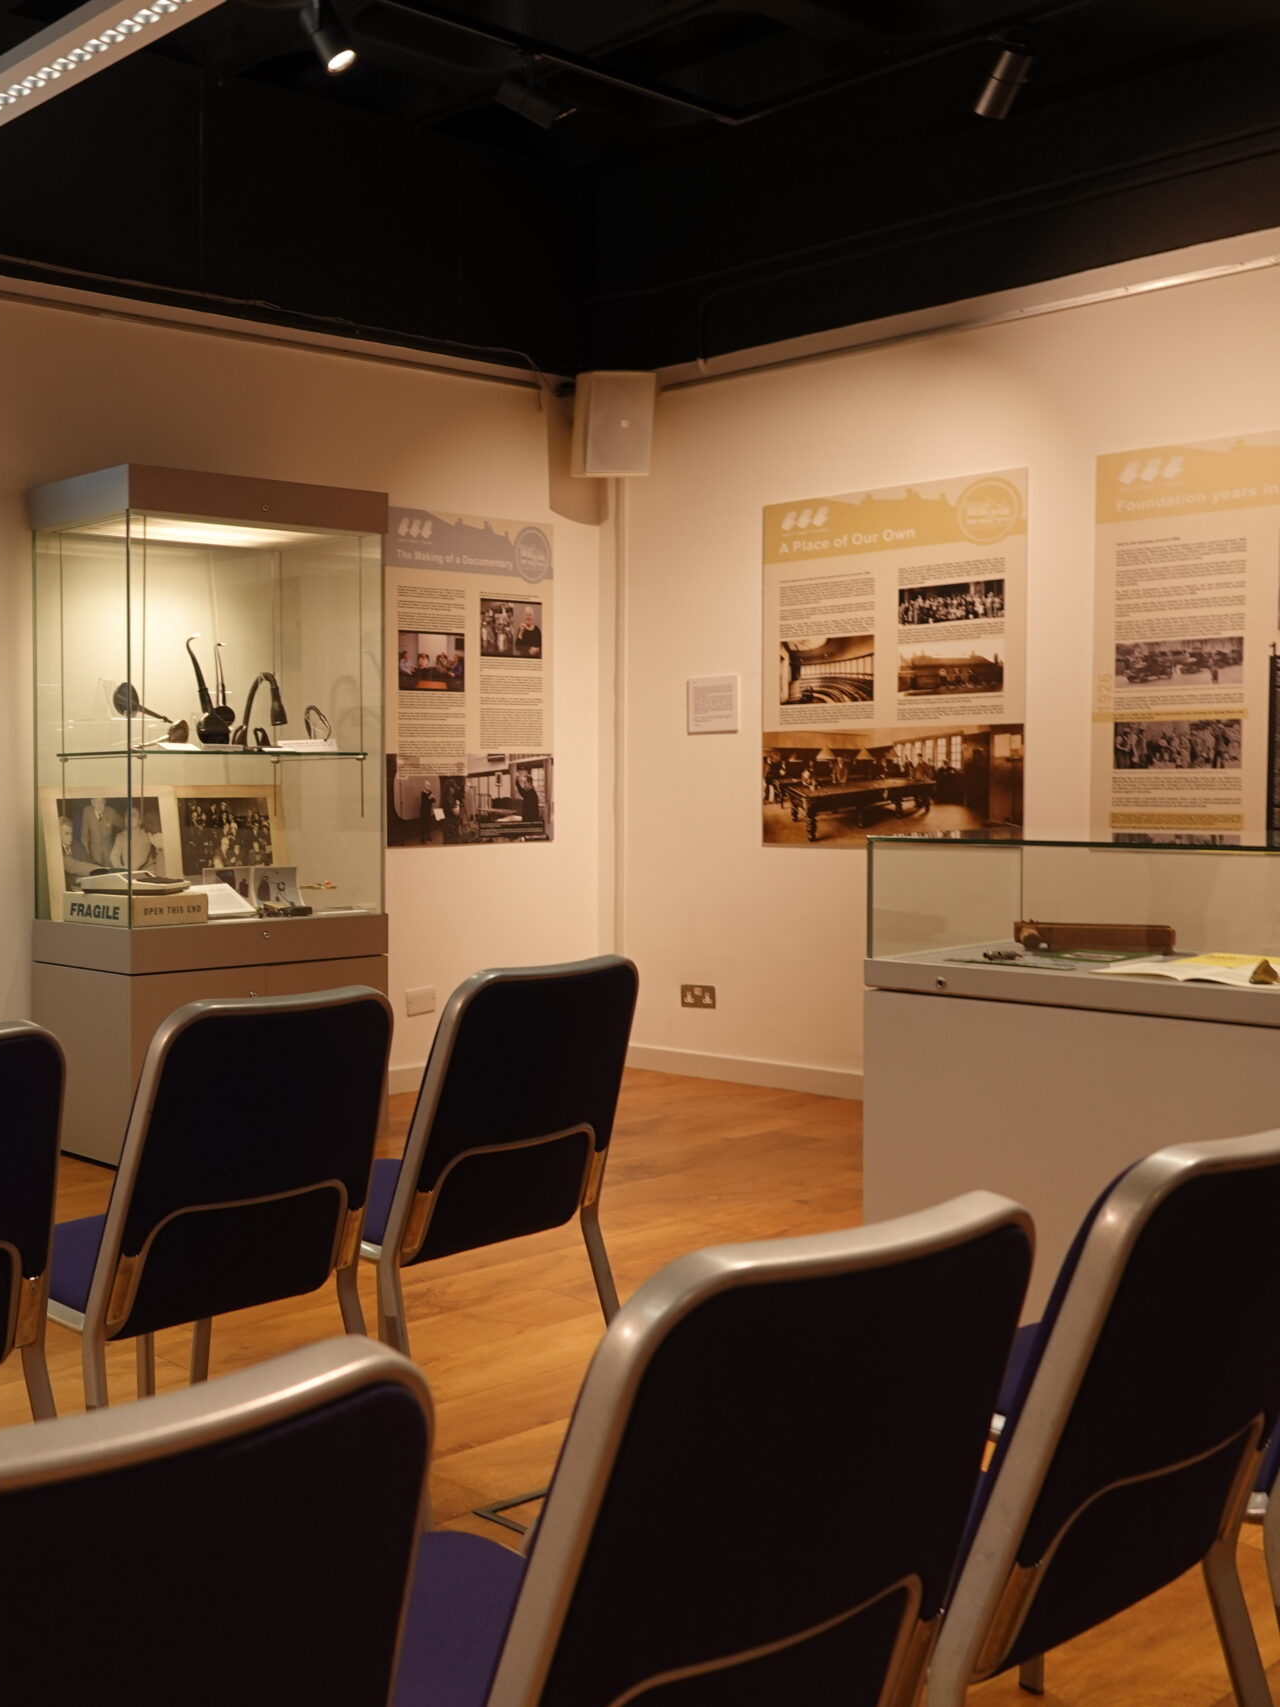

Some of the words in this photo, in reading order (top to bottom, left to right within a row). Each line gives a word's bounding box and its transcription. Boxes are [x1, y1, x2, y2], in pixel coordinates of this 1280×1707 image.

[1116, 491, 1207, 512] Foundation
[1211, 486, 1257, 504] years
[779, 543, 790, 554] A
[792, 538, 830, 553] Place
[833, 534, 849, 548] of
[851, 532, 879, 545] Our
[882, 528, 916, 542] Own
[396, 548, 412, 560] The
[414, 550, 444, 565] Making
[445, 553, 455, 563] of
[462, 554, 513, 571] Documentary
[70, 902, 121, 920] FRAGILE
[143, 906, 163, 916] OPEN
[167, 905, 184, 915] THIS
[187, 904, 202, 914] END
